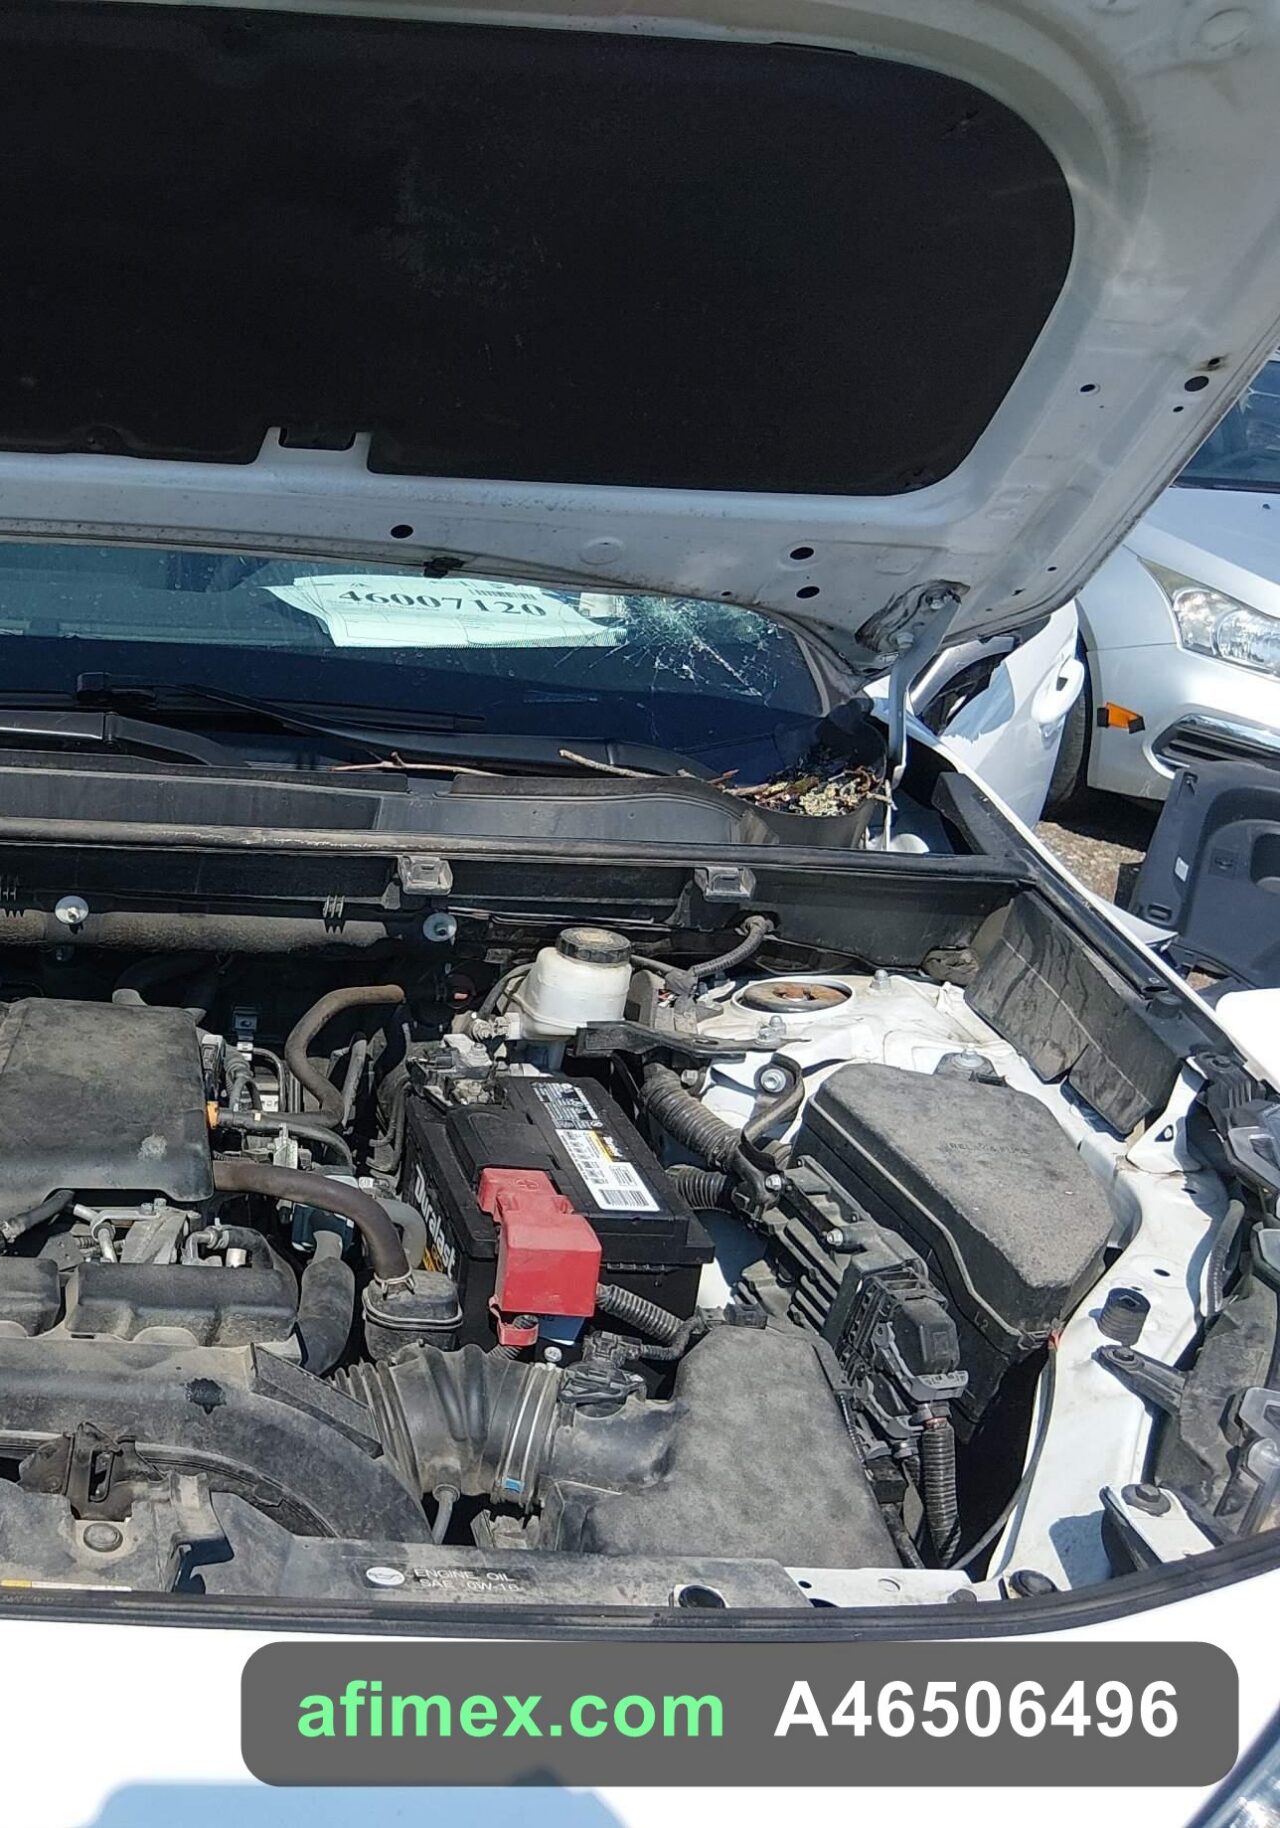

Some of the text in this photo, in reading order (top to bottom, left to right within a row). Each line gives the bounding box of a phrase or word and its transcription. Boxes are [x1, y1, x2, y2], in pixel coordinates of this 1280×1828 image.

[339, 590, 546, 617] 46007120
[414, 1568, 516, 1582] ENGINE OIL
[420, 1579, 451, 1588] SAE
